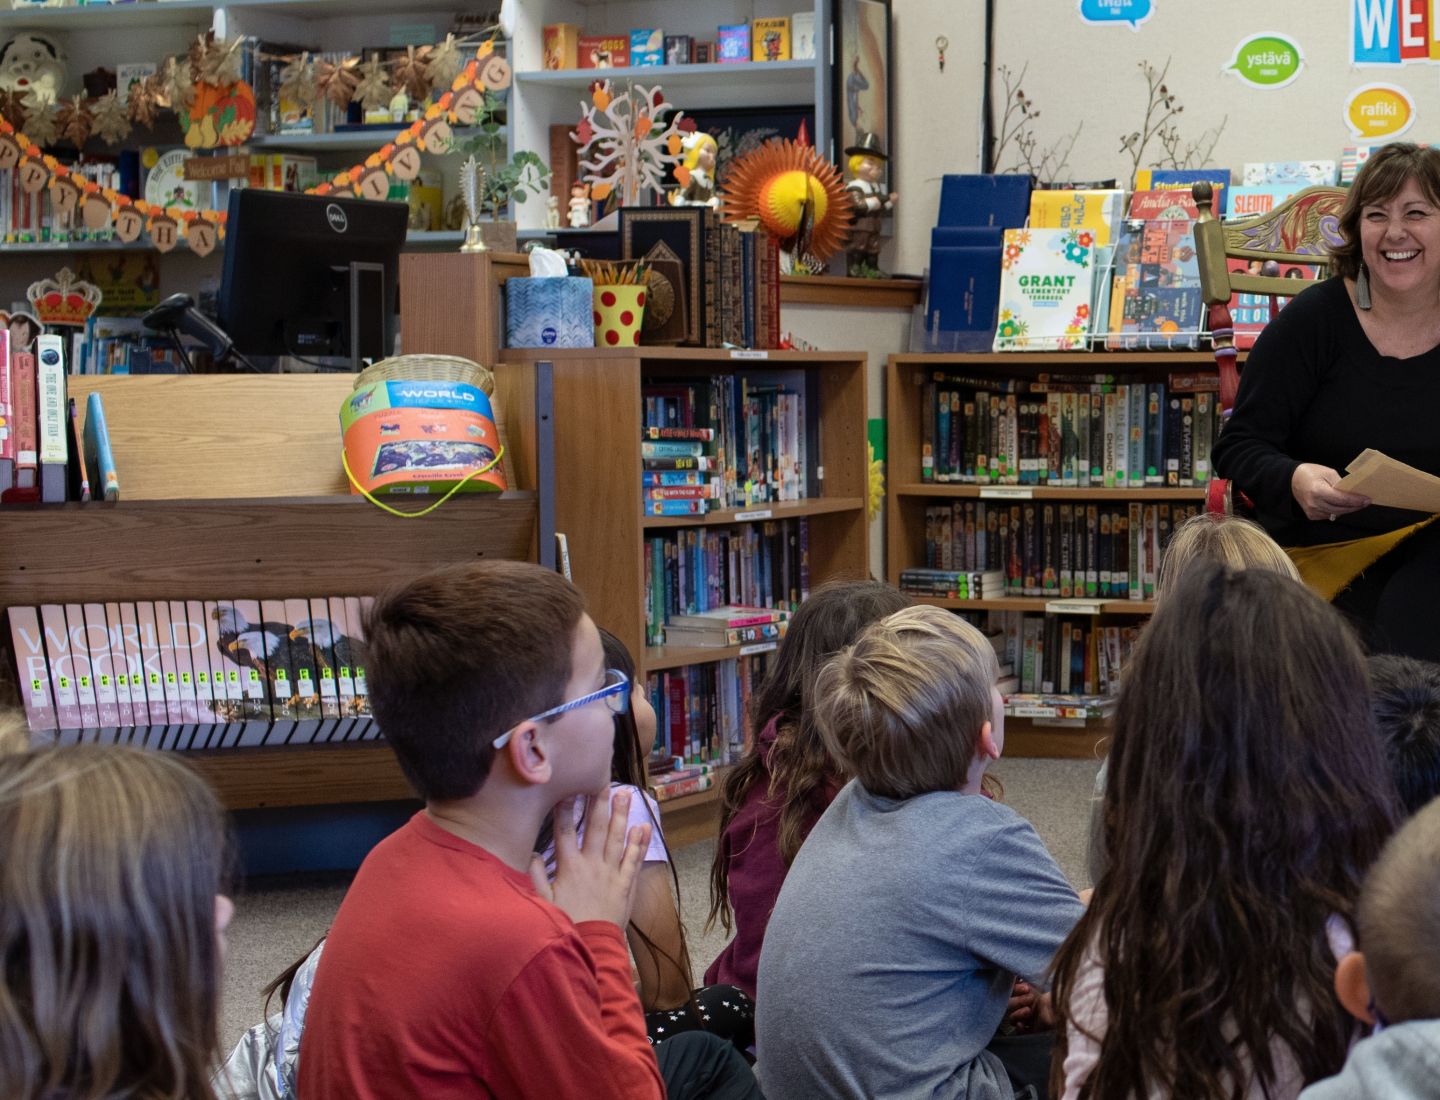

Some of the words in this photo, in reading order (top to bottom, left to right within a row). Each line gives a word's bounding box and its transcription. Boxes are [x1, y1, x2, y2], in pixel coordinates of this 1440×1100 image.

[1247, 52, 1291, 68] ystävä
[1360, 102, 1396, 116] rafiki
[1234, 194, 1273, 213] SLEUTH
[1019, 275, 1076, 287] GRANT
[401, 390, 475, 401] WORLD
[1106, 432, 1114, 472] CHAMPIO
[18, 622, 206, 654] WORLD
[26, 650, 169, 683] BOOK
